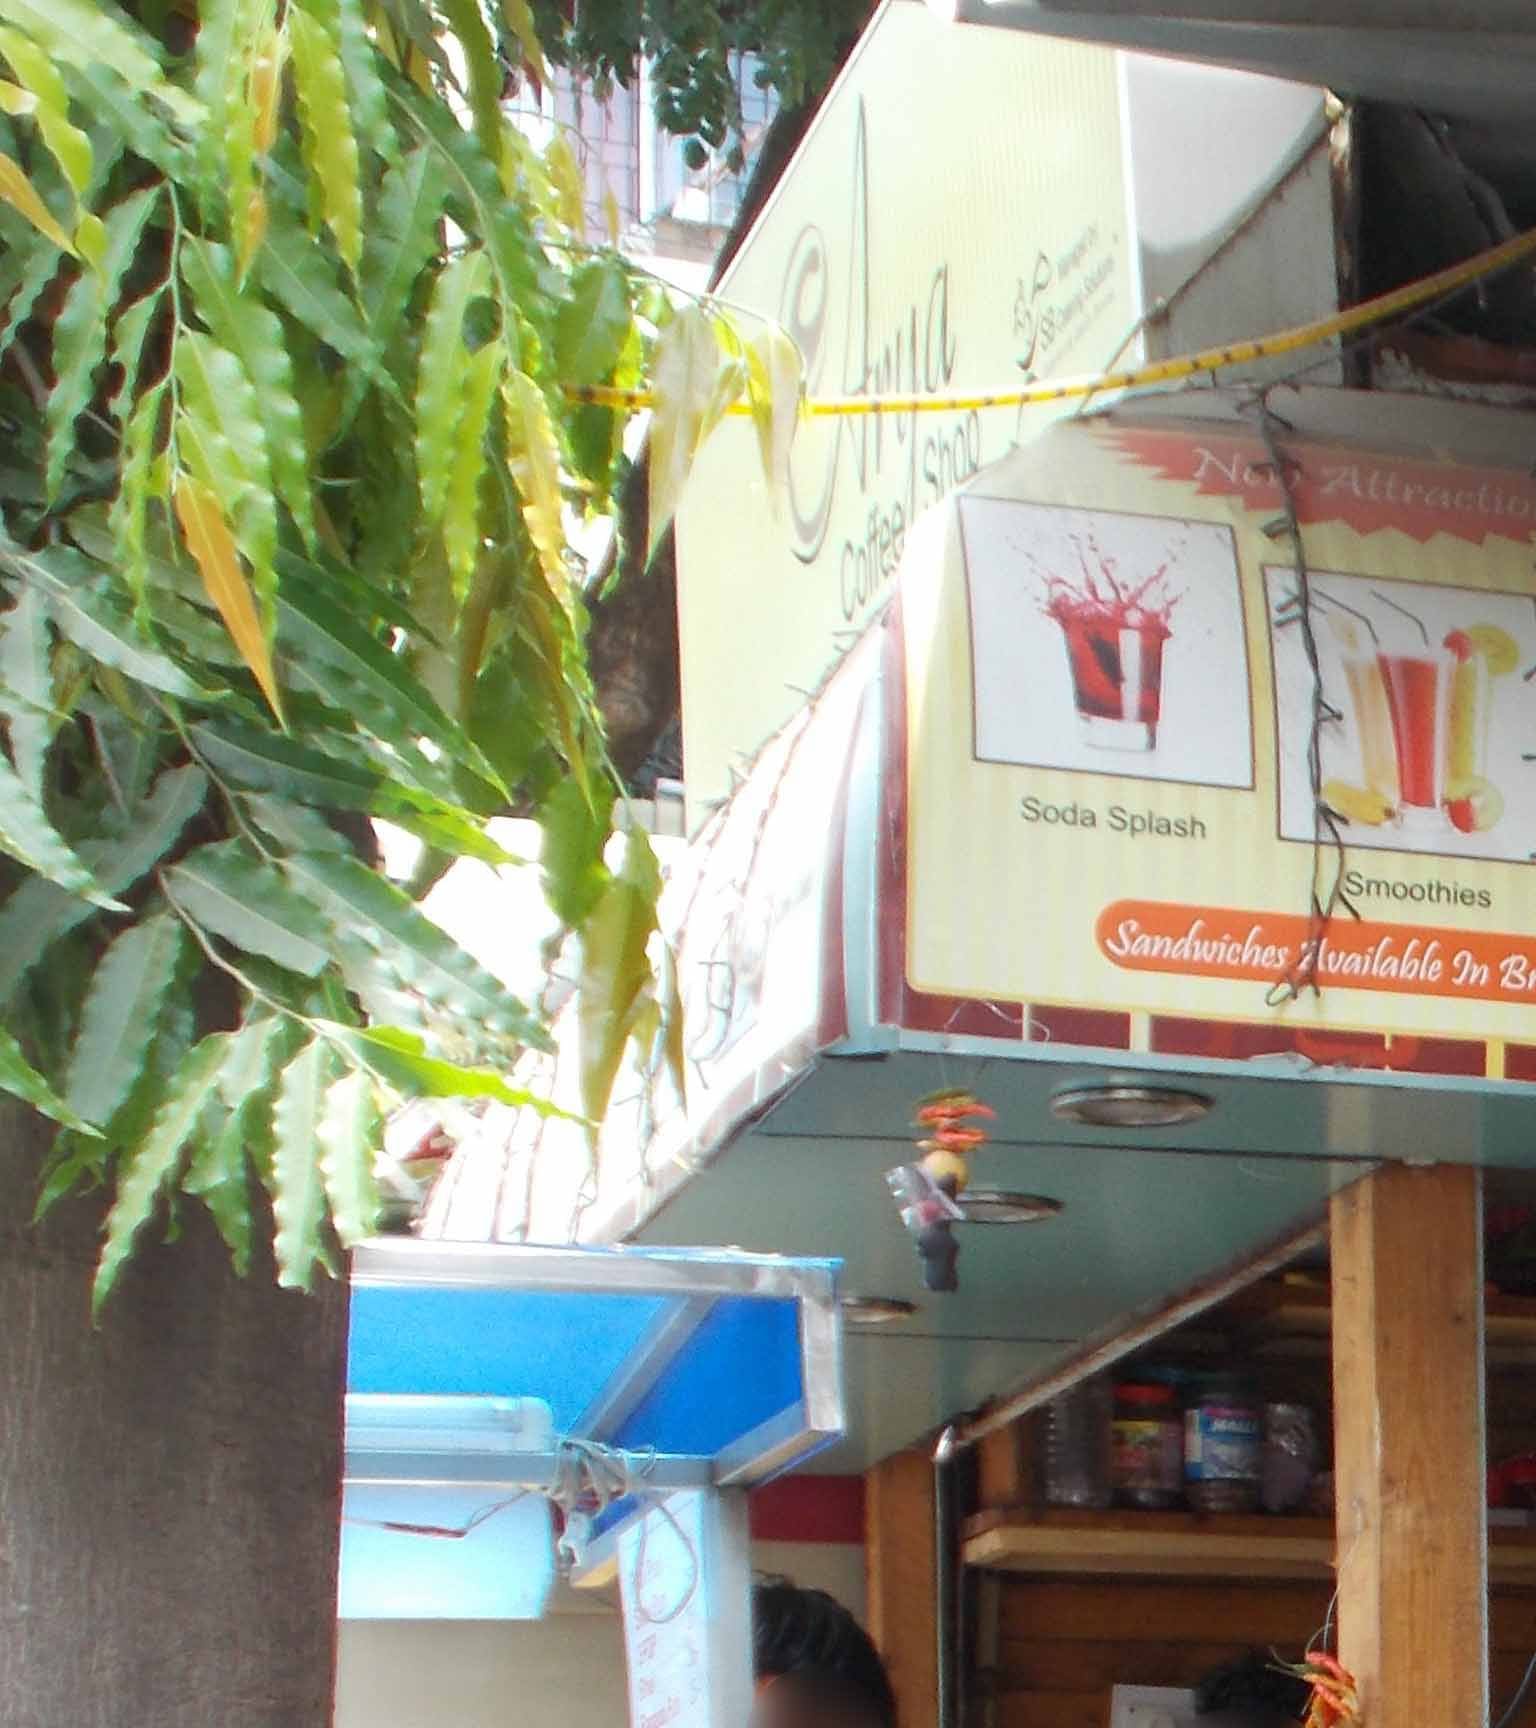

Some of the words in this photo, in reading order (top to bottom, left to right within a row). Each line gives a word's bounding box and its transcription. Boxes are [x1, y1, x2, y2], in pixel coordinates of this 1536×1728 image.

[1021, 796, 1097, 830] Soda
[1108, 805, 1207, 841] Splash
[1345, 871, 1492, 909] Smoothies
[1106, 918, 1288, 971] Sandwiches
[1452, 949, 1489, 987] In
